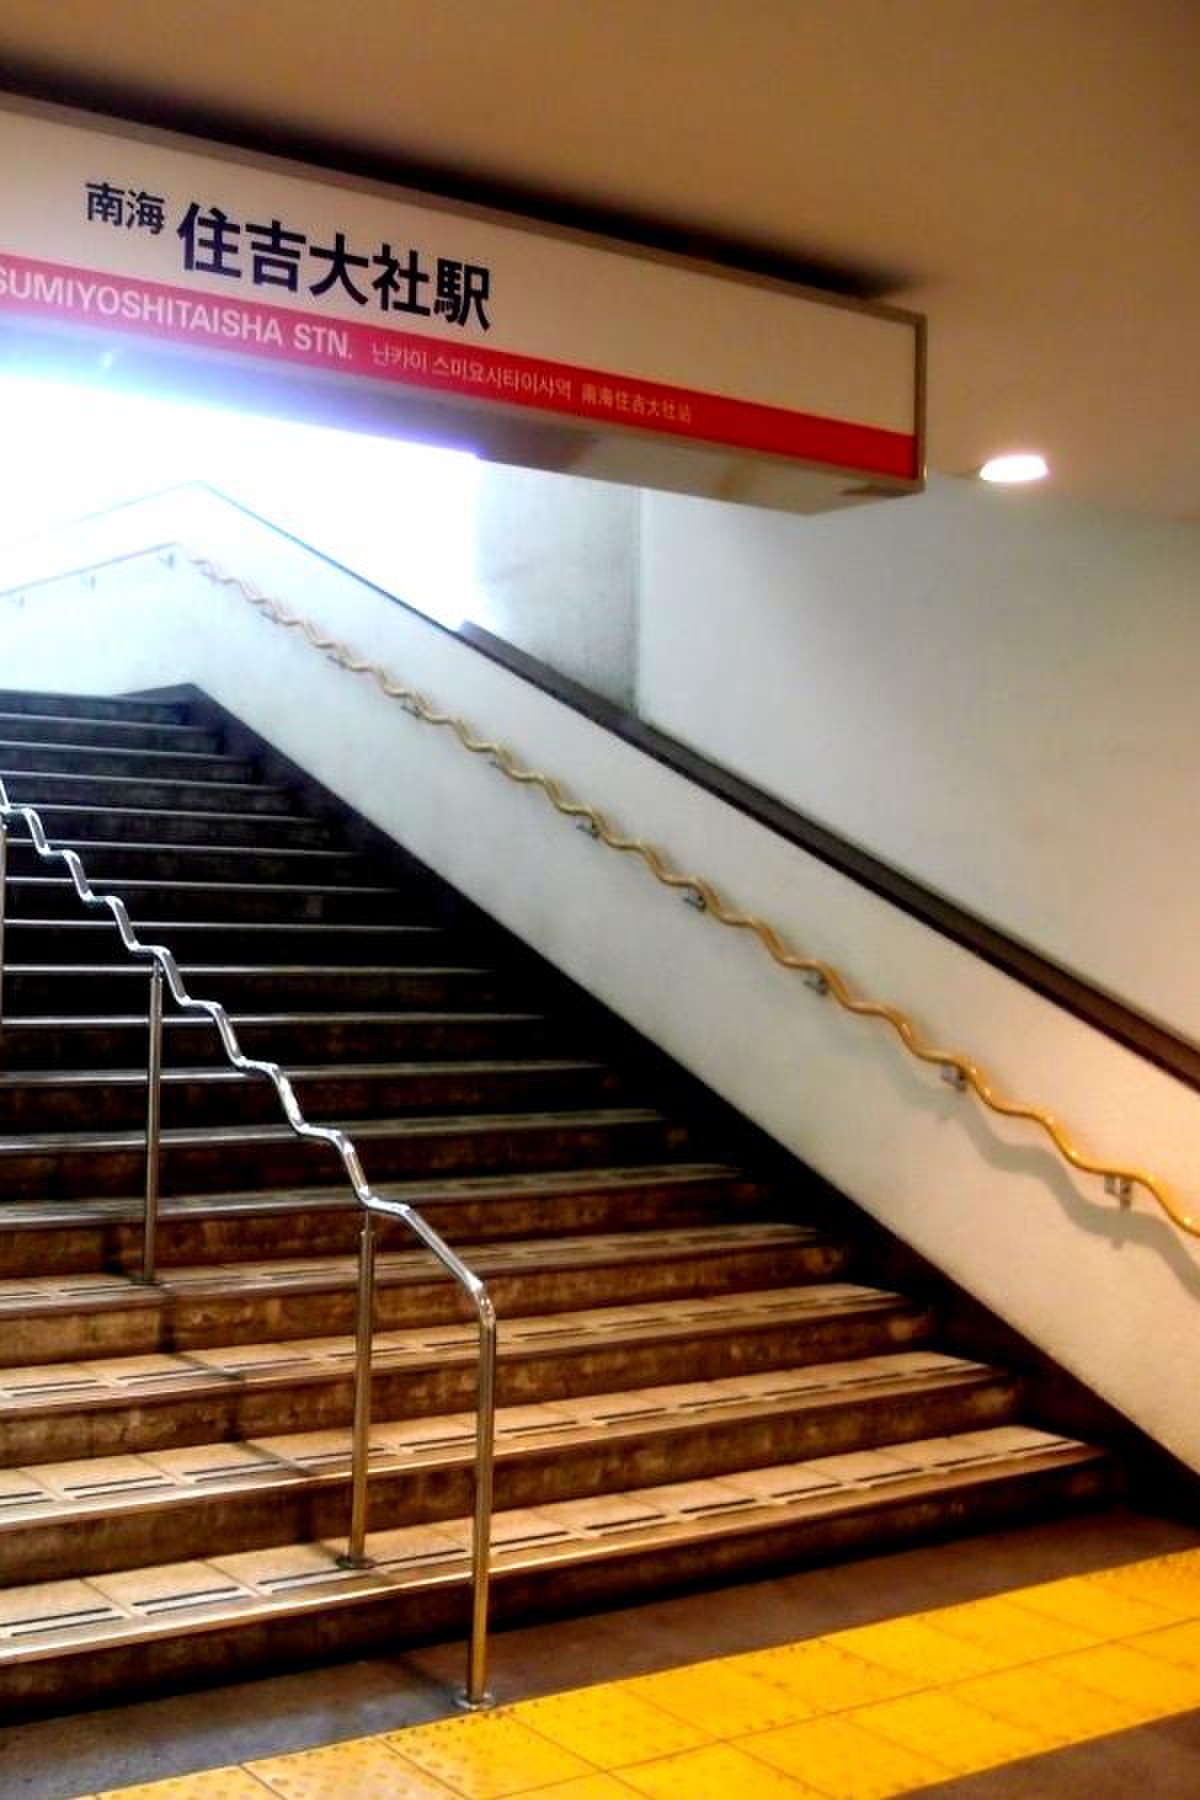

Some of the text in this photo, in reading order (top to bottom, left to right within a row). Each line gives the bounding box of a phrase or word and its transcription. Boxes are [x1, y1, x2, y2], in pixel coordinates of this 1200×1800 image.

[85, 182, 491, 331] 南海 住吉大社駅
[293, 323, 352, 359] STN.
